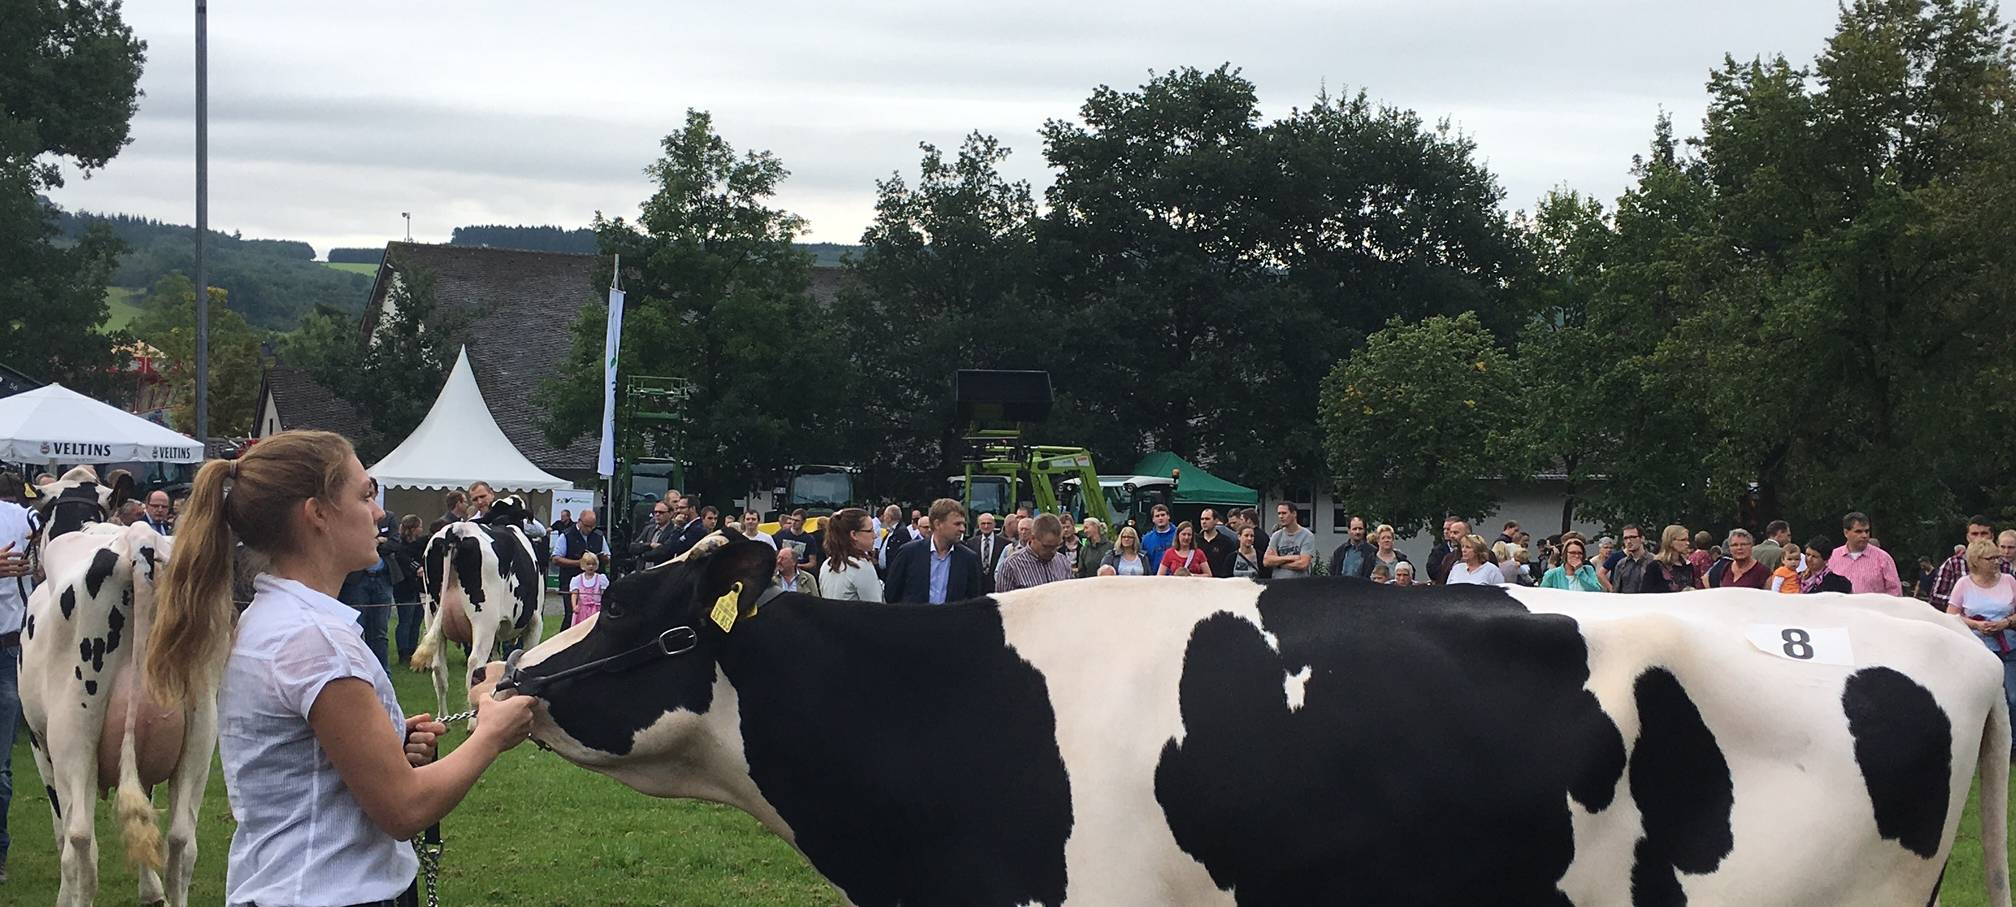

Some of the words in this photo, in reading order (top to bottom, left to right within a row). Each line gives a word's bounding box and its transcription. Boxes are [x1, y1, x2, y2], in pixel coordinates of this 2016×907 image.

[53, 442, 112, 457] VELTINS
[159, 446, 191, 460] VELTINS
[1781, 628, 1814, 660] 8
